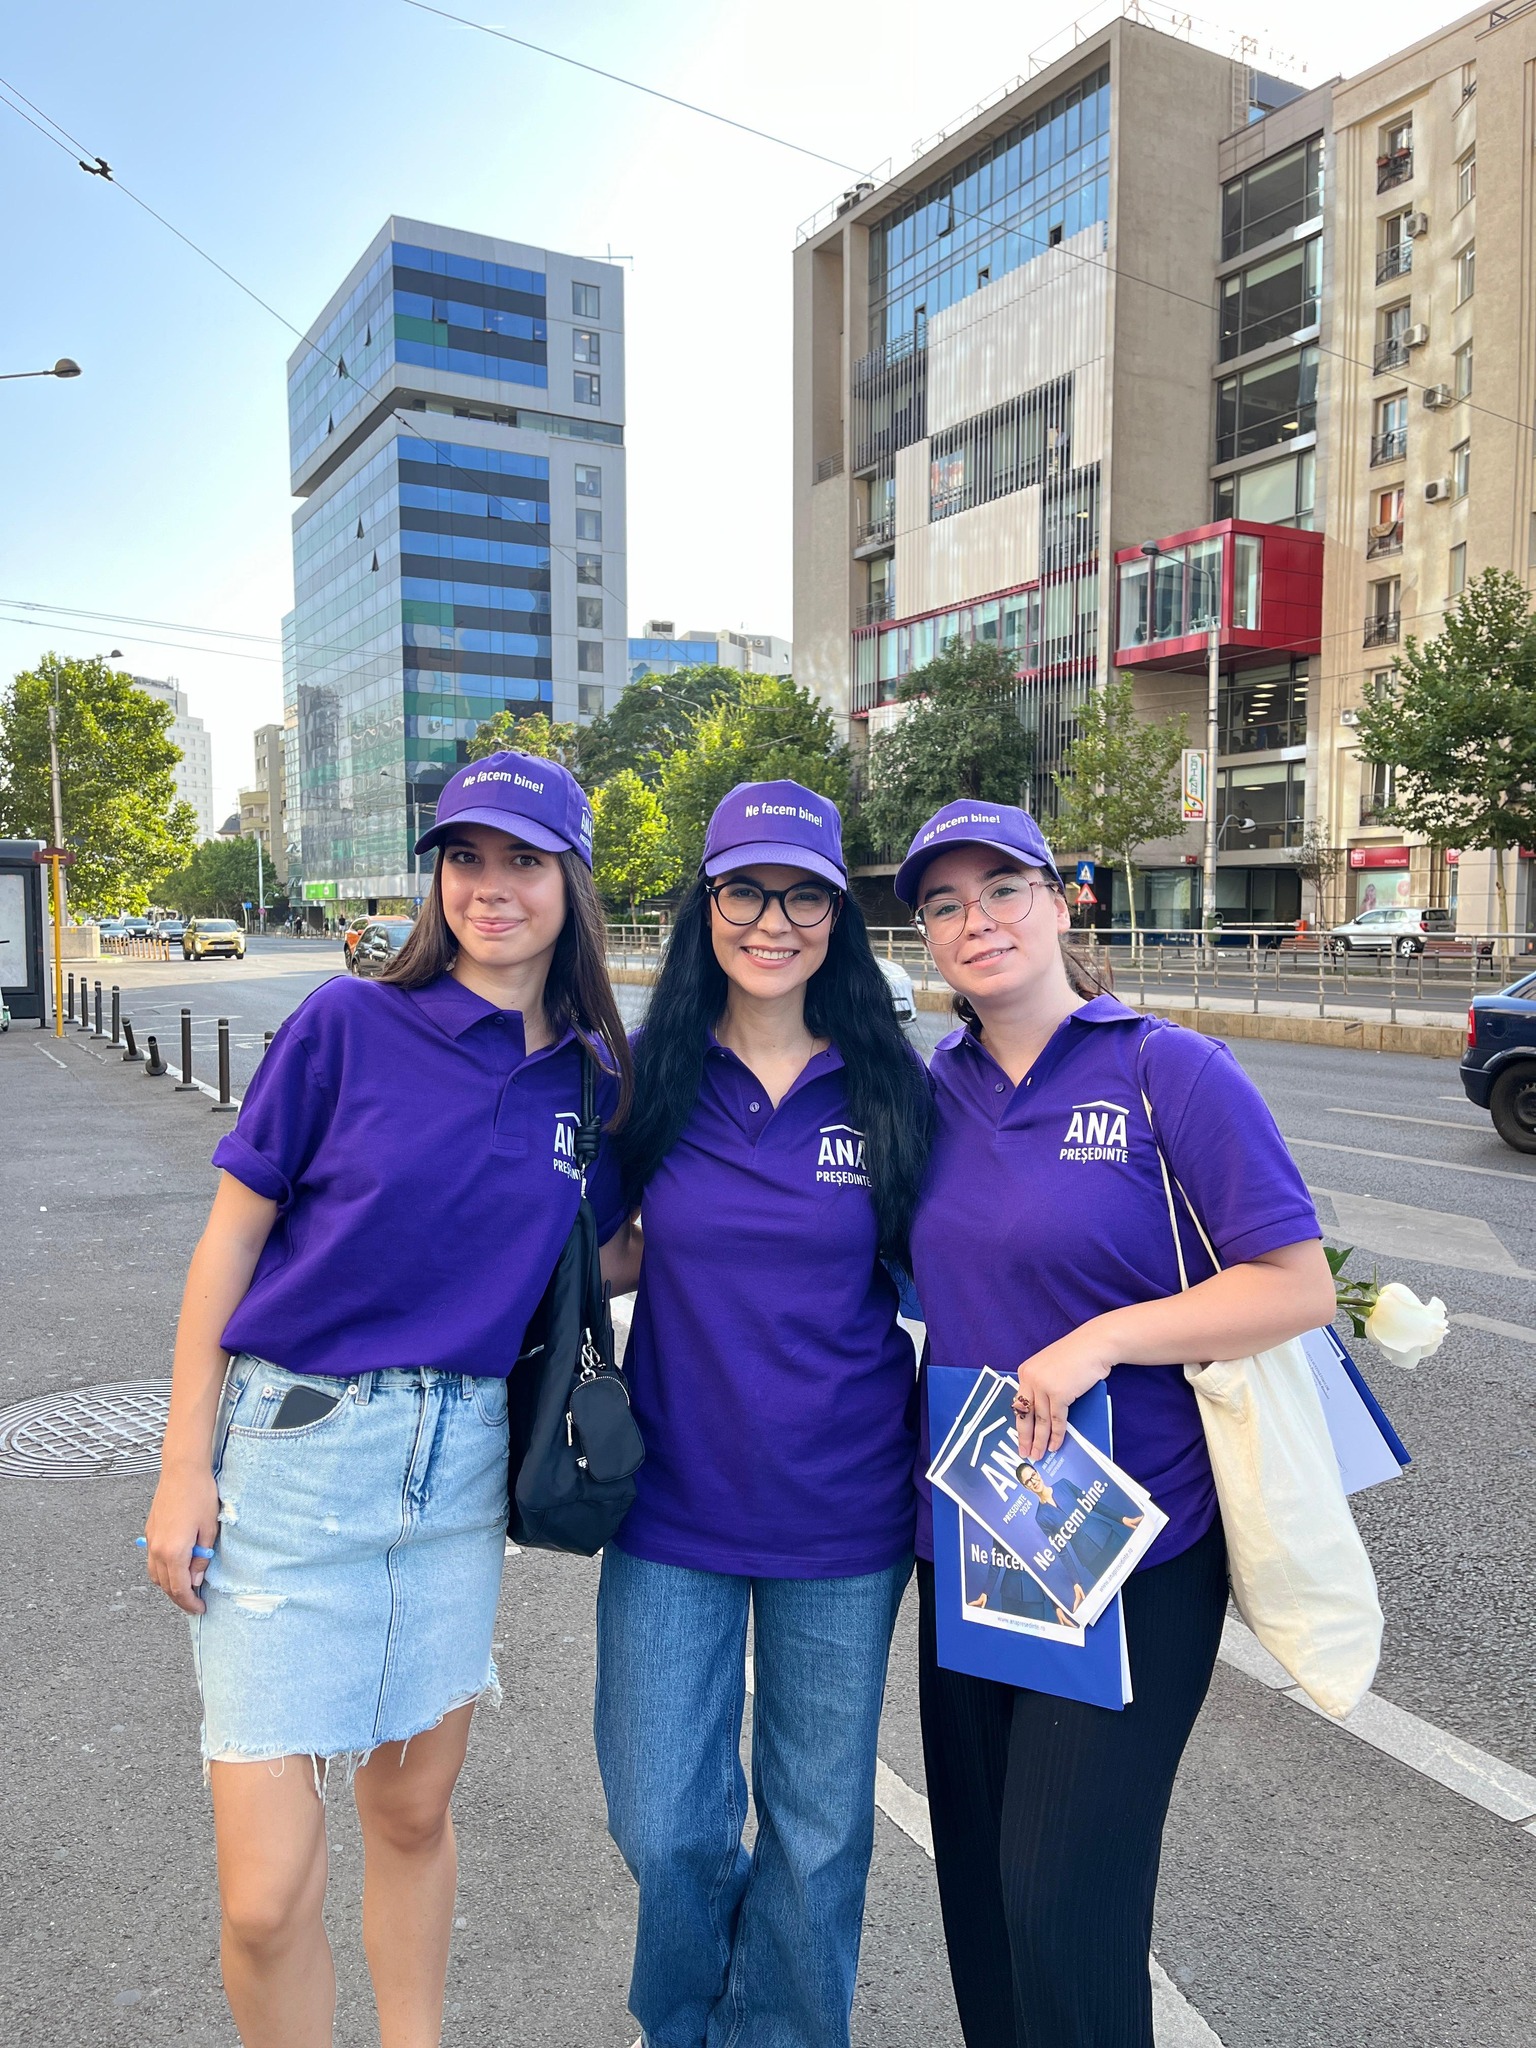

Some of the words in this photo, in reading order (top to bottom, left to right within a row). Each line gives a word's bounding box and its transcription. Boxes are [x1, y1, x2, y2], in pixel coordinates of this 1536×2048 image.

[462, 776, 476, 788] Ne
[477, 771, 512, 784] facem
[514, 773, 544, 794] bine!
[745, 804, 759, 818] Ne
[761, 802, 796, 817] facem
[798, 806, 823, 827] bine!
[923, 830, 935, 844] Ne
[936, 814, 968, 834] facem
[971, 813, 1000, 824] bine!
[554, 1122, 576, 1161] AN
[1063, 1111, 1127, 1148] ANA
[818, 1136, 867, 1170] ANA
[1059, 1147, 1128, 1165] PREȘEDINTE
[816, 1170, 872, 1188] PREȘEDINTE
[1002, 1493, 1028, 1525] PREȘEDINTE
[1020, 1500, 1033, 1516] 2024
[1033, 1548, 1056, 1572] Ne
[1048, 1508, 1086, 1553] facem
[1076, 1480, 1108, 1513] bine.
[971, 1543, 988, 1564] Ne
